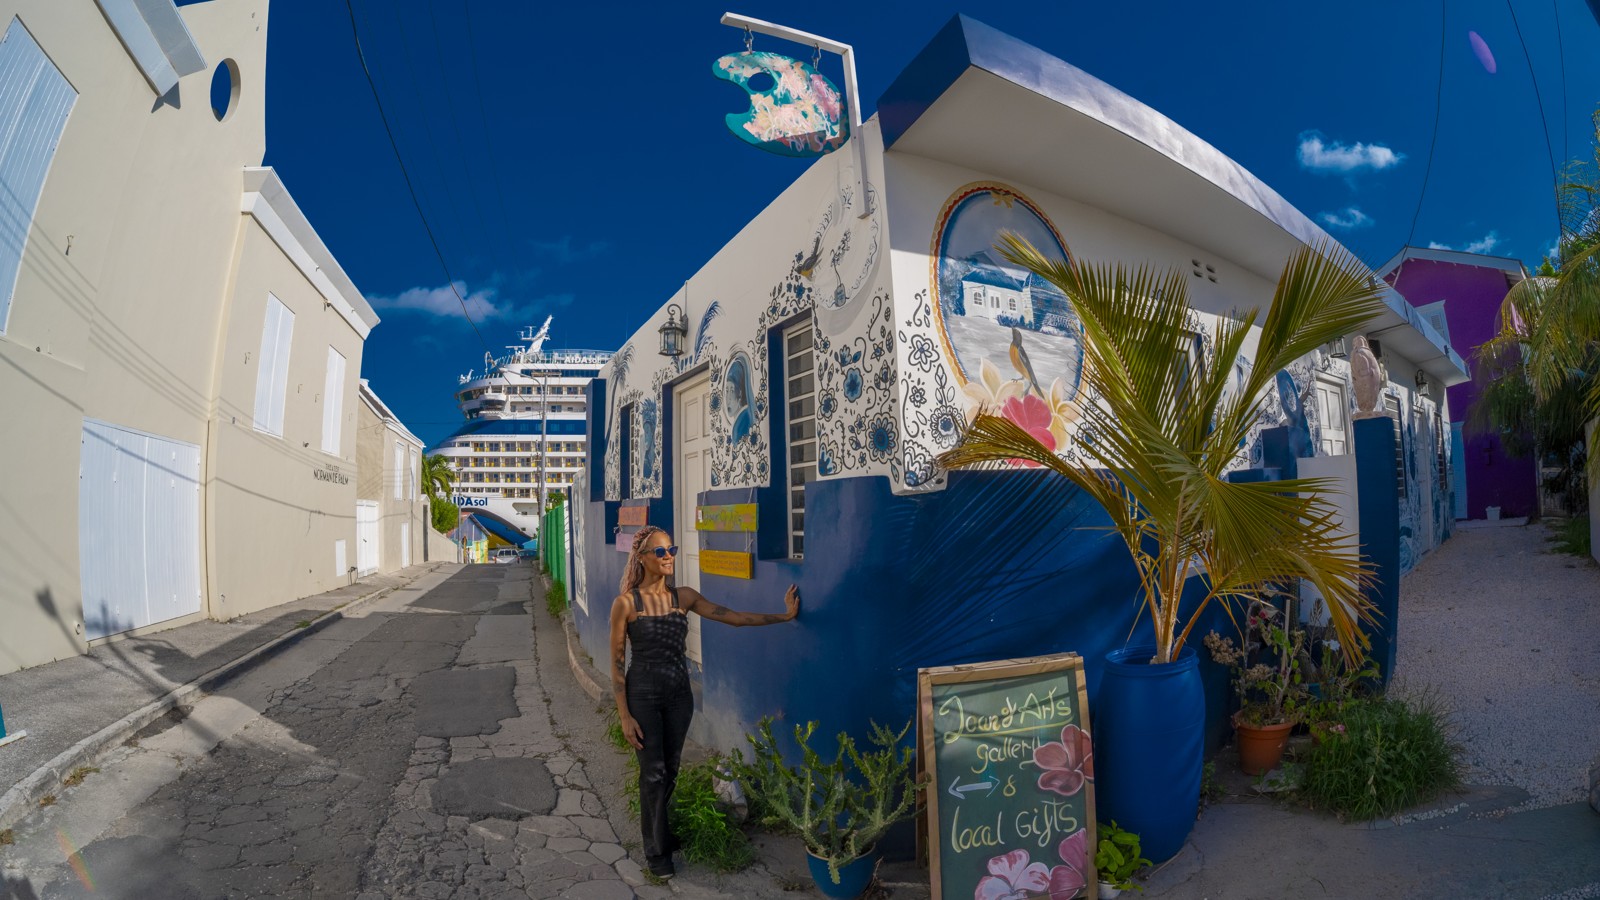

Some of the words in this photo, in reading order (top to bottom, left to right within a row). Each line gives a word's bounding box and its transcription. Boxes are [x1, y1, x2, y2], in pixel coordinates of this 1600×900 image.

[453, 496, 488, 506] IDAsol
[939, 695, 1001, 744] Joan
[1018, 686, 1071, 724] Arts
